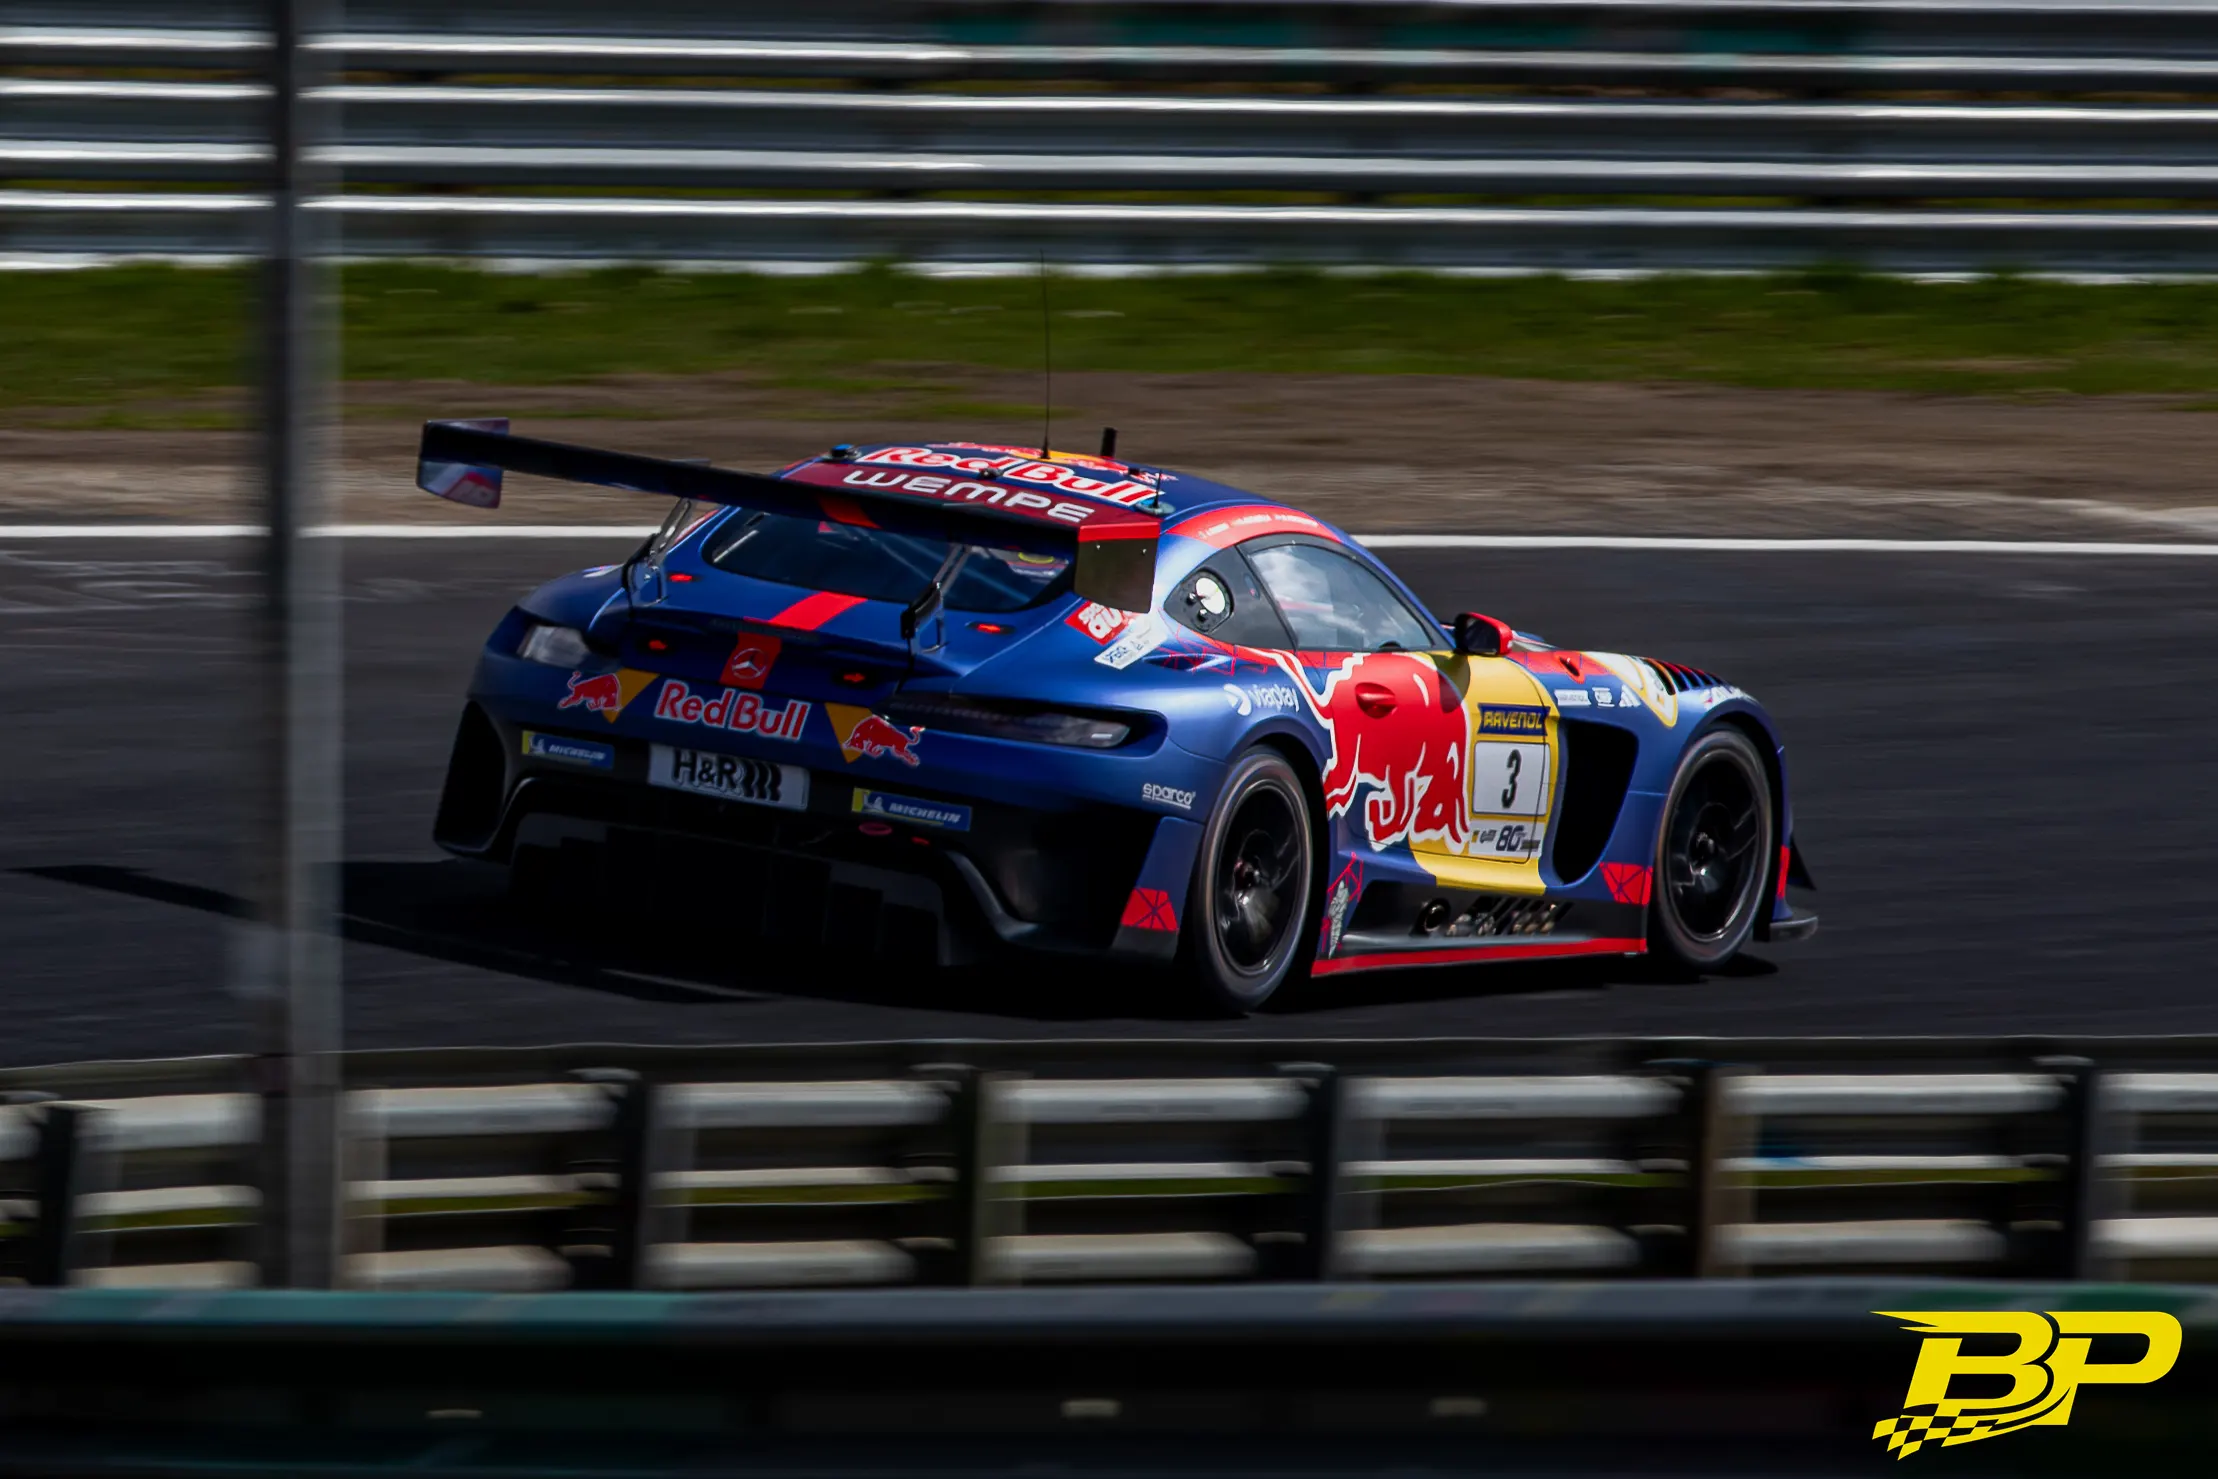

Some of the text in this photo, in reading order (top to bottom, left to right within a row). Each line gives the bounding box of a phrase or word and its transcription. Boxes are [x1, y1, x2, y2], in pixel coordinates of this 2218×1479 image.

[857, 447, 1165, 506] Red Bull
[843, 470, 1095, 523] WEMPE
[654, 679, 811, 741] Red Bull
[1250, 683, 1300, 712] viaplay
[1483, 710, 1543, 730] RAVENOL
[548, 744, 606, 761] MICHELIN
[1501, 749, 1522, 809] 3
[1143, 783, 1192, 806] sparco
[889, 803, 961, 823] MICHELIN
